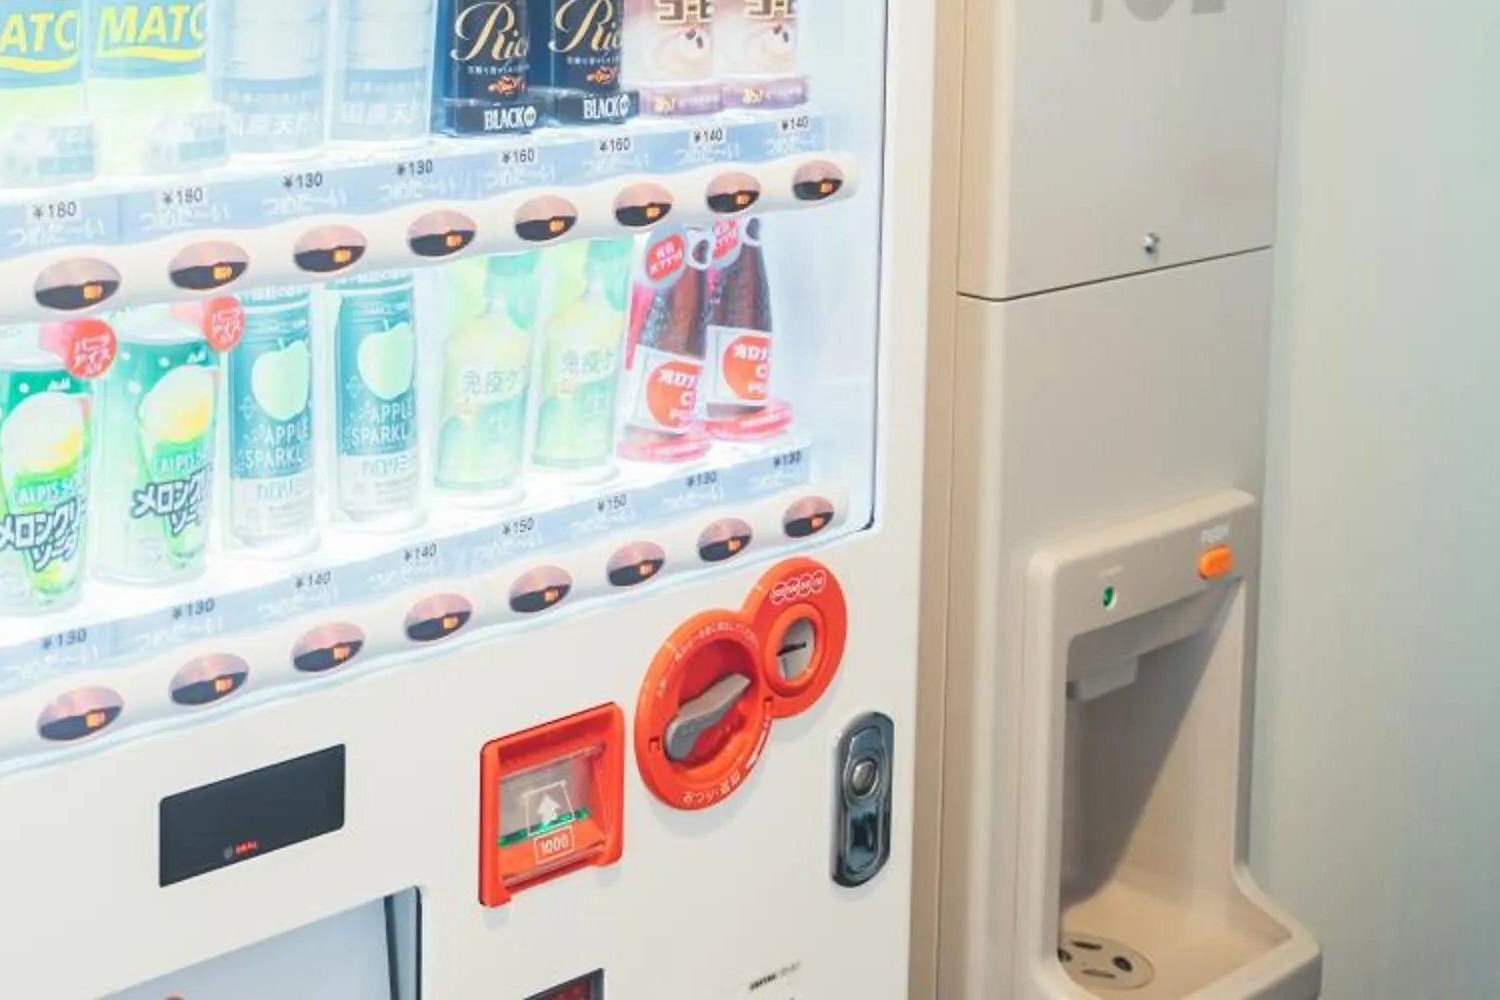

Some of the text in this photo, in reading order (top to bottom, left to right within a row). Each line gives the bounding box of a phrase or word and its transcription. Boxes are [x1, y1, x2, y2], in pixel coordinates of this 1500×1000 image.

[484, 107, 525, 131] BLACK
[32, 200, 78, 221] ¥180
[541, 834, 570, 852] 1000
